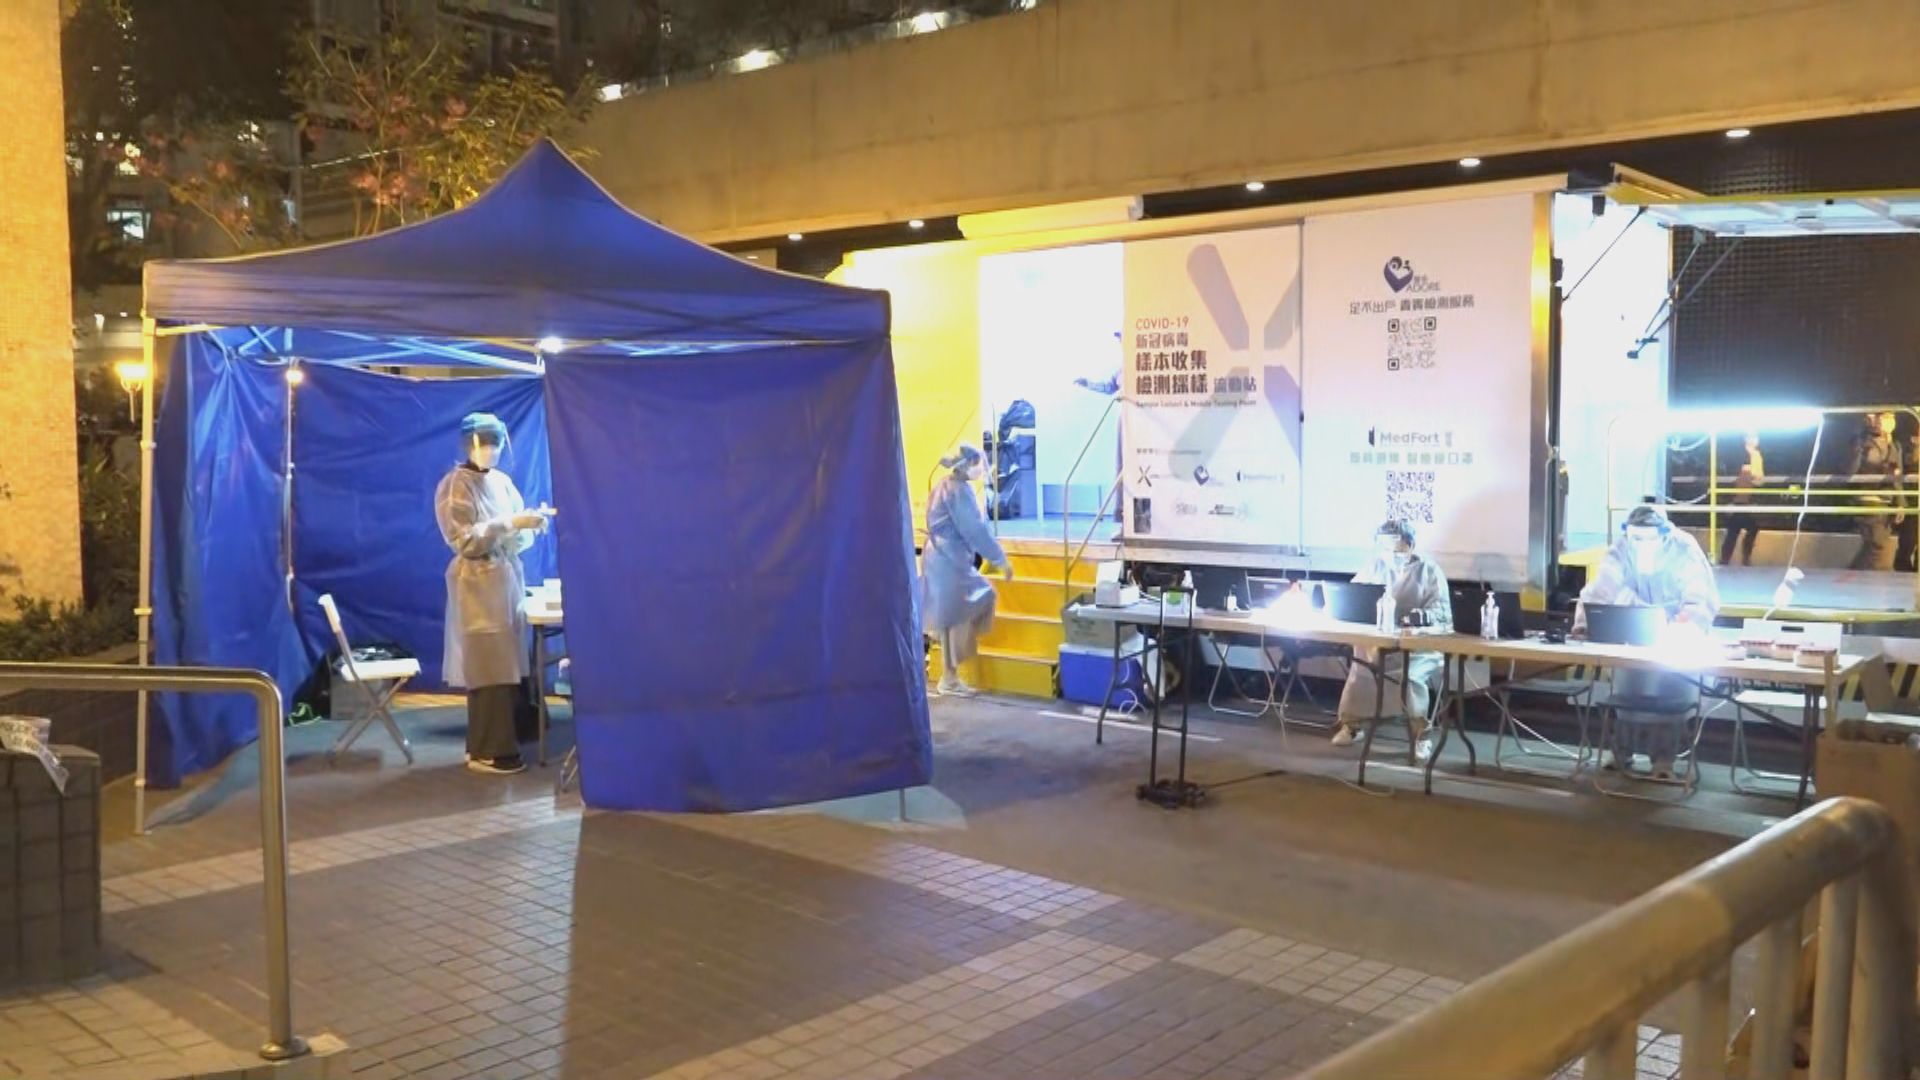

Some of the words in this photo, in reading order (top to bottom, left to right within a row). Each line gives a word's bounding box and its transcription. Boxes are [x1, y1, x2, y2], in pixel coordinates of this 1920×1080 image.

[1136, 316, 1189, 330] COVID-19
[1136, 332, 1188, 349] 新冠病毒
[1136, 350, 1207, 371] 樣本收集
[1380, 432, 1439, 443] MedFort
